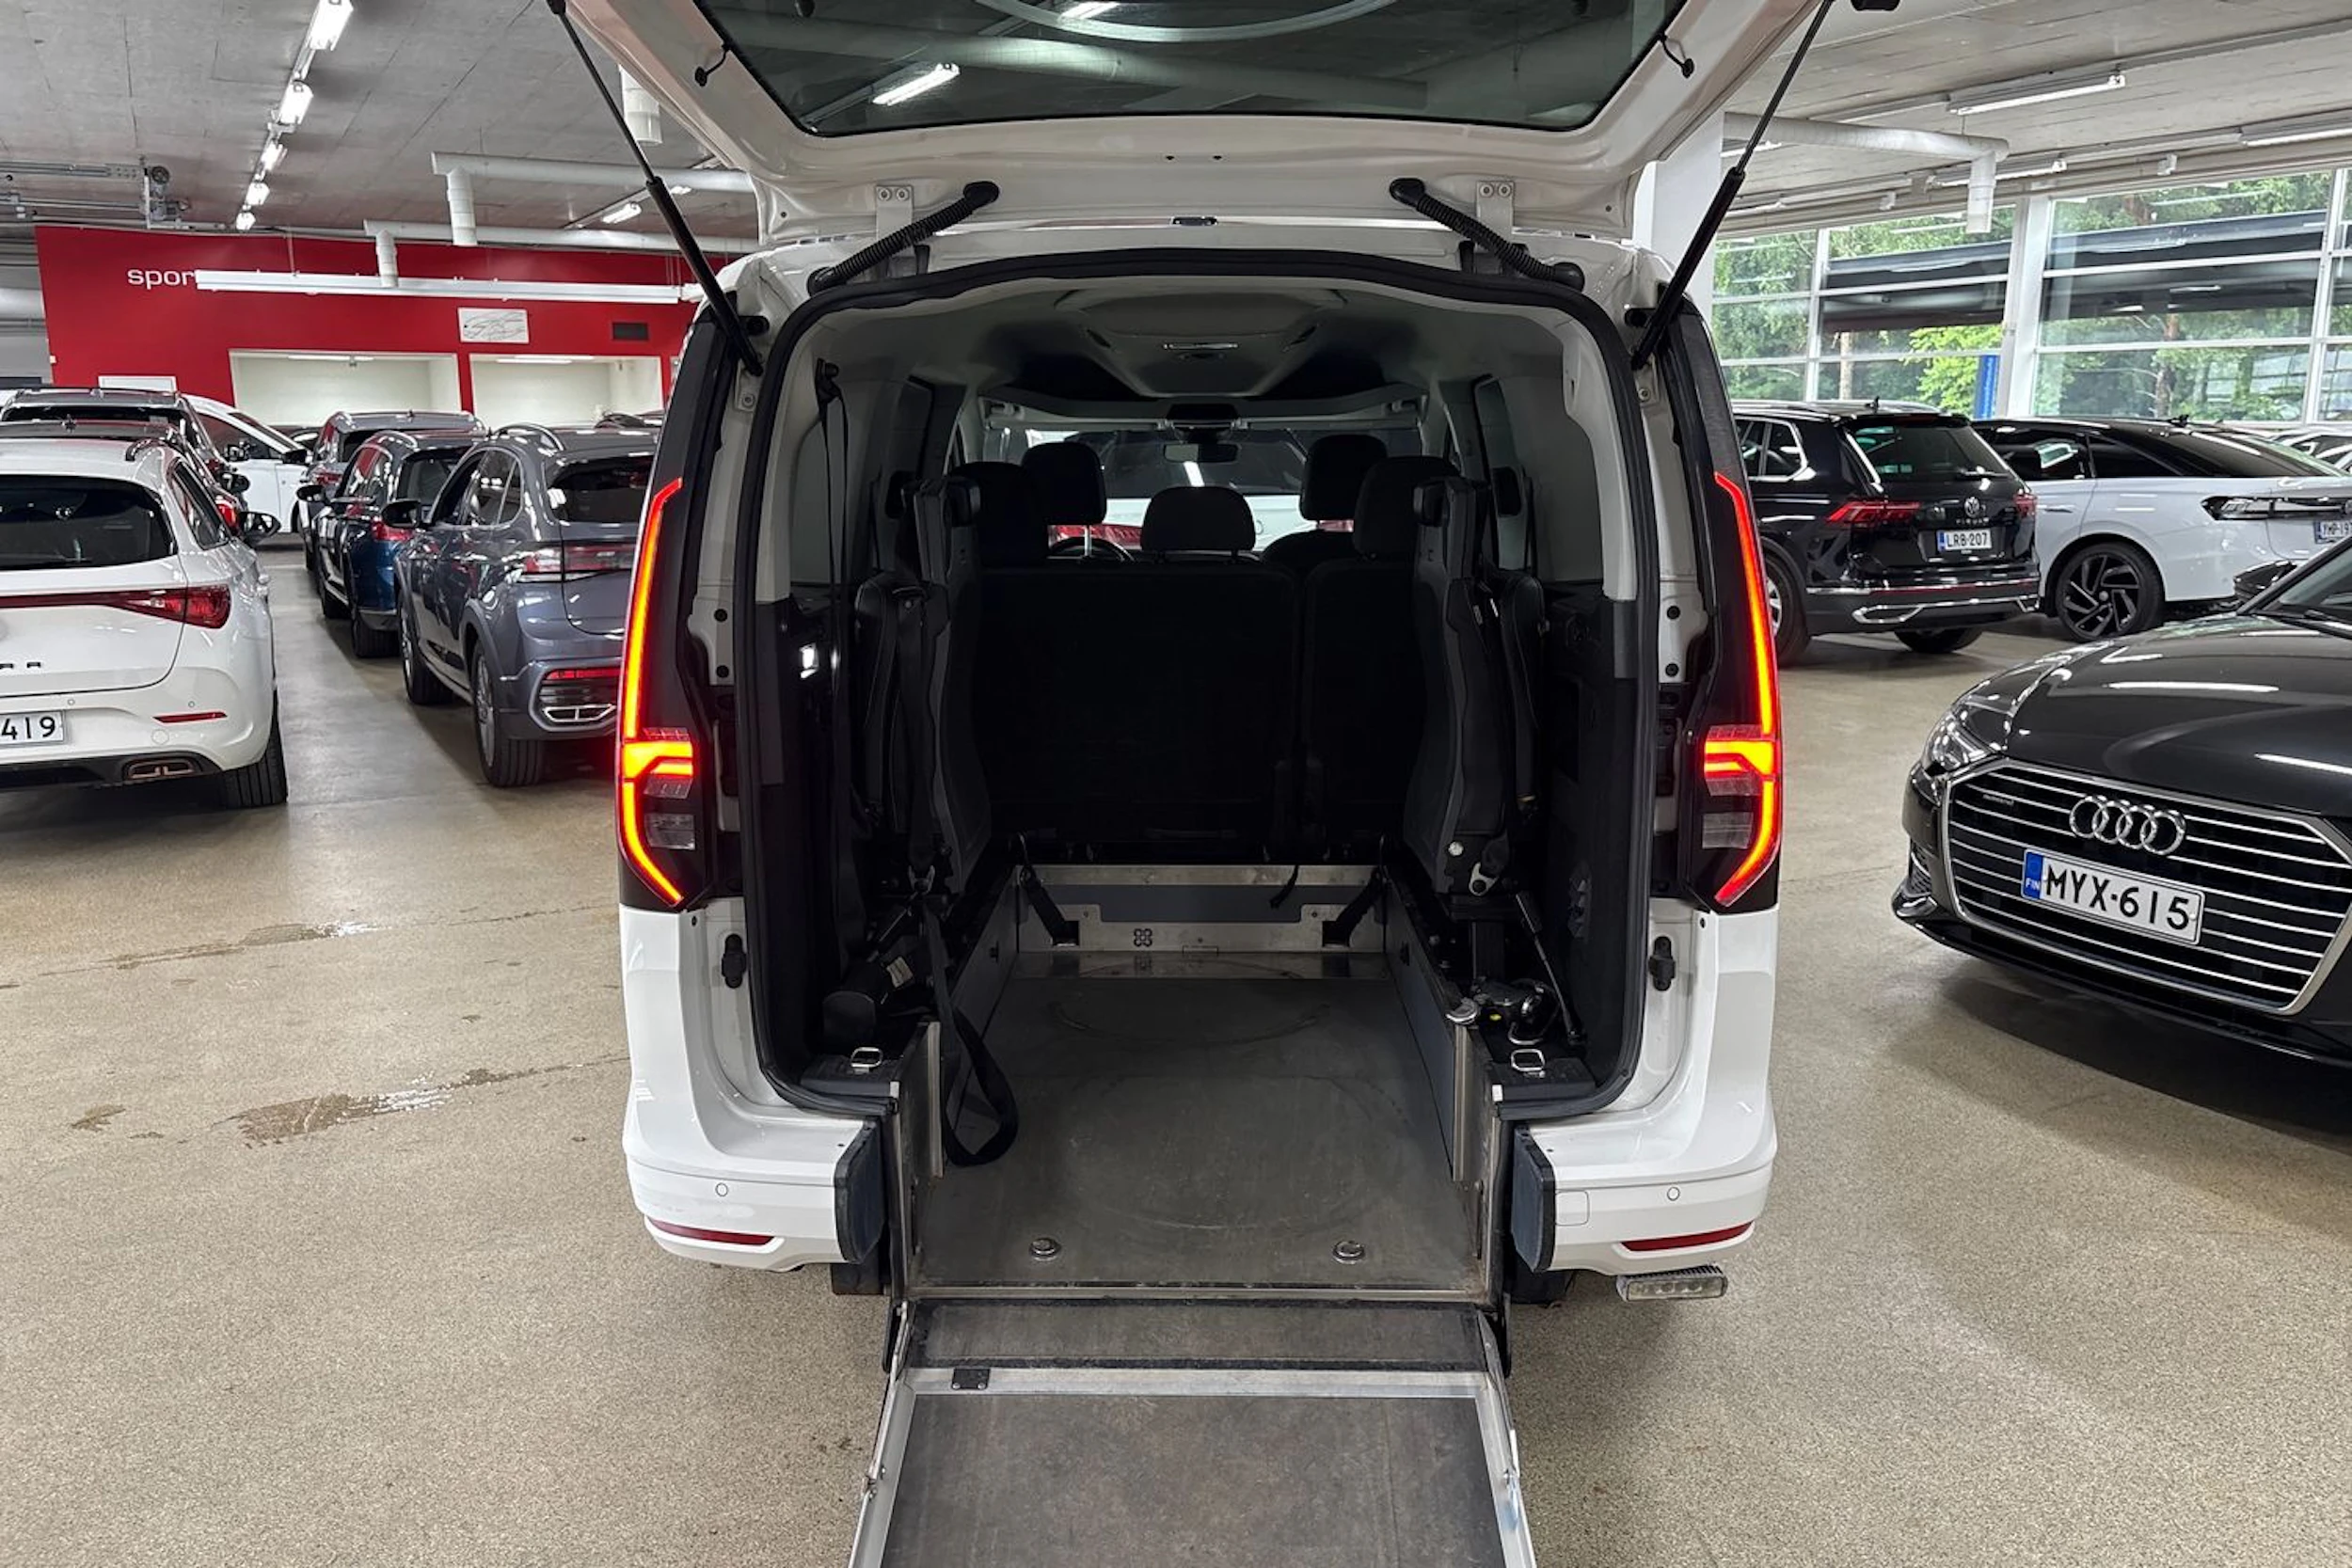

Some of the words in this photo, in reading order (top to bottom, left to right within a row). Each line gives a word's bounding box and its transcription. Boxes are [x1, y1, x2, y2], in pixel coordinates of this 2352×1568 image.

[127, 268, 195, 290] spor
[2026, 877, 2041, 891] FIN
[2046, 864, 2189, 930] MYX-615
